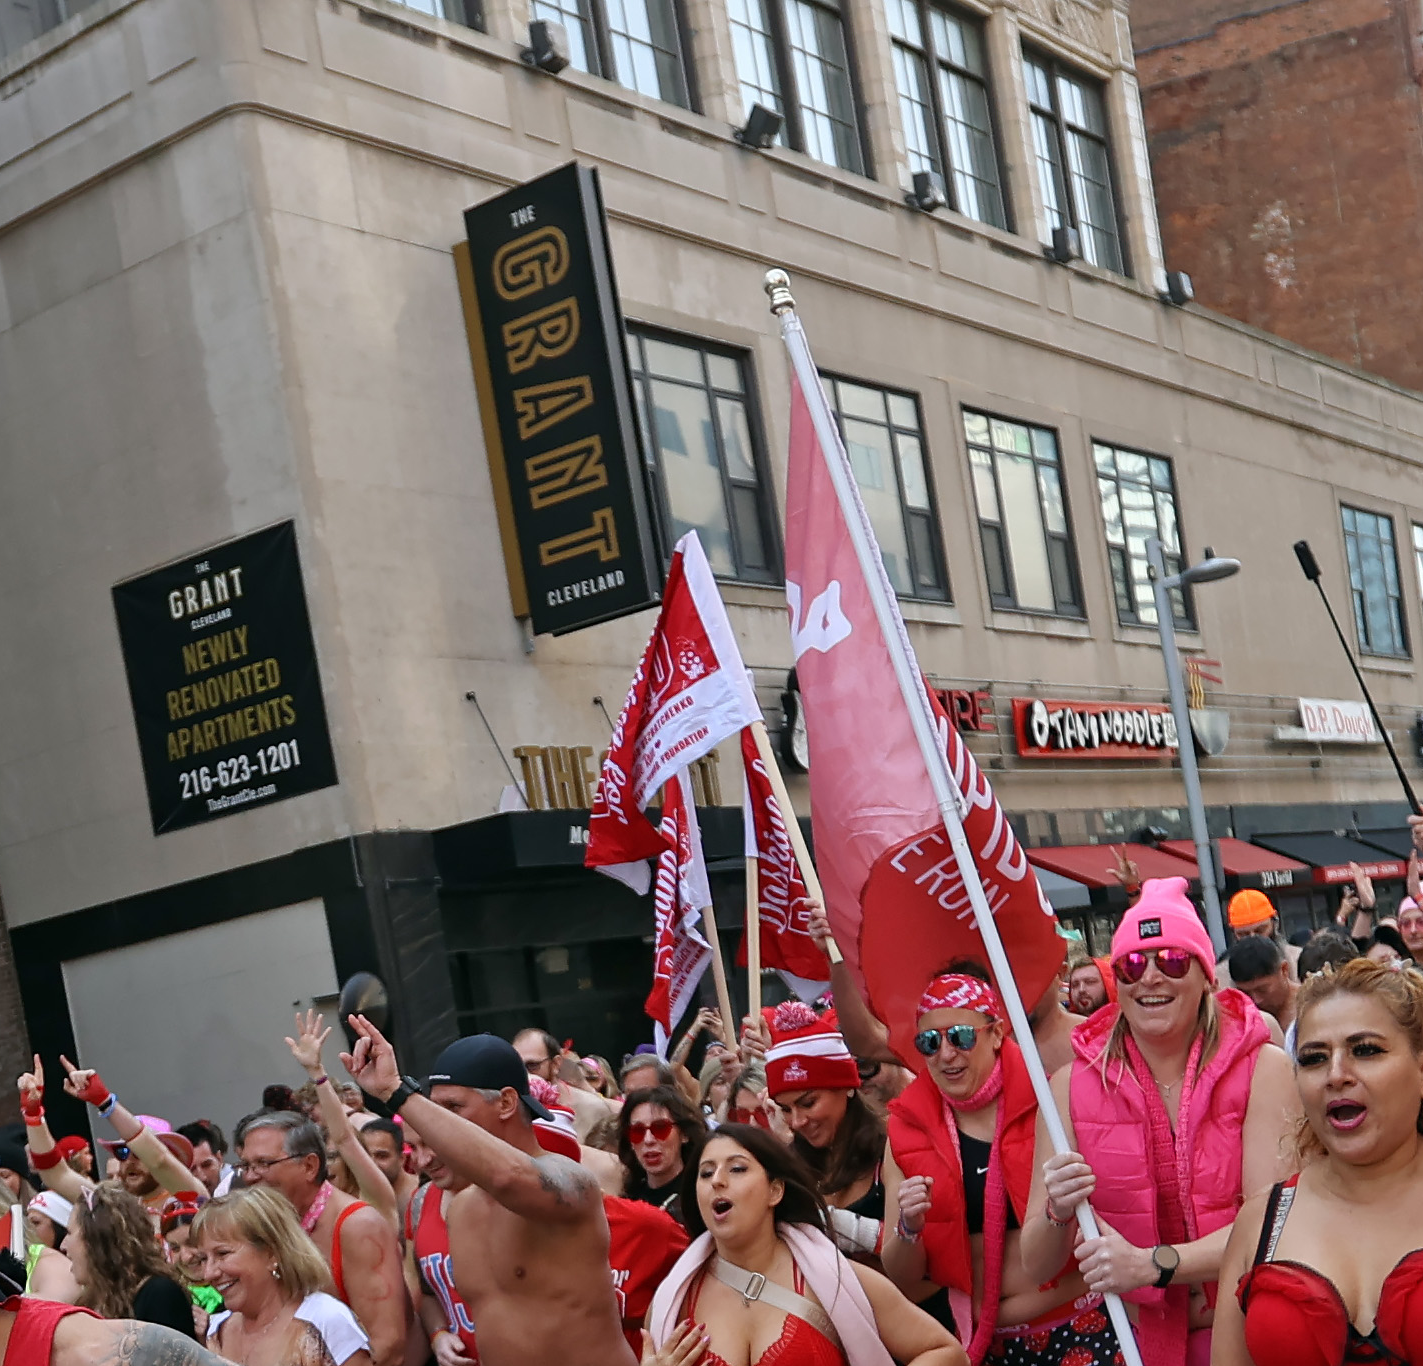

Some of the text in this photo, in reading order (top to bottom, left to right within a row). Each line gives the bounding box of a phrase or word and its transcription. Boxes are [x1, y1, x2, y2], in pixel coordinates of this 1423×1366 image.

[509, 205, 536, 228] THE
[492, 225, 621, 567] GRANT
[194, 560, 211, 574] THE
[546, 569, 625, 607] CLEVELAND
[168, 566, 244, 620] GRANT
[191, 607, 233, 631] CLEVELAND
[182, 624, 249, 675] NEWLY
[166, 657, 281, 722] RENOVATED
[167, 694, 297, 762] APARTMENTS
[660, 725, 709, 764] FOUNDATION
[1030, 699, 1099, 749] OTANI
[1304, 705, 1372, 740] D.P. Dough
[179, 738, 301, 799] 216-623-1201
[514, 746, 596, 808] THE
[913, 855, 1011, 932] RUN
